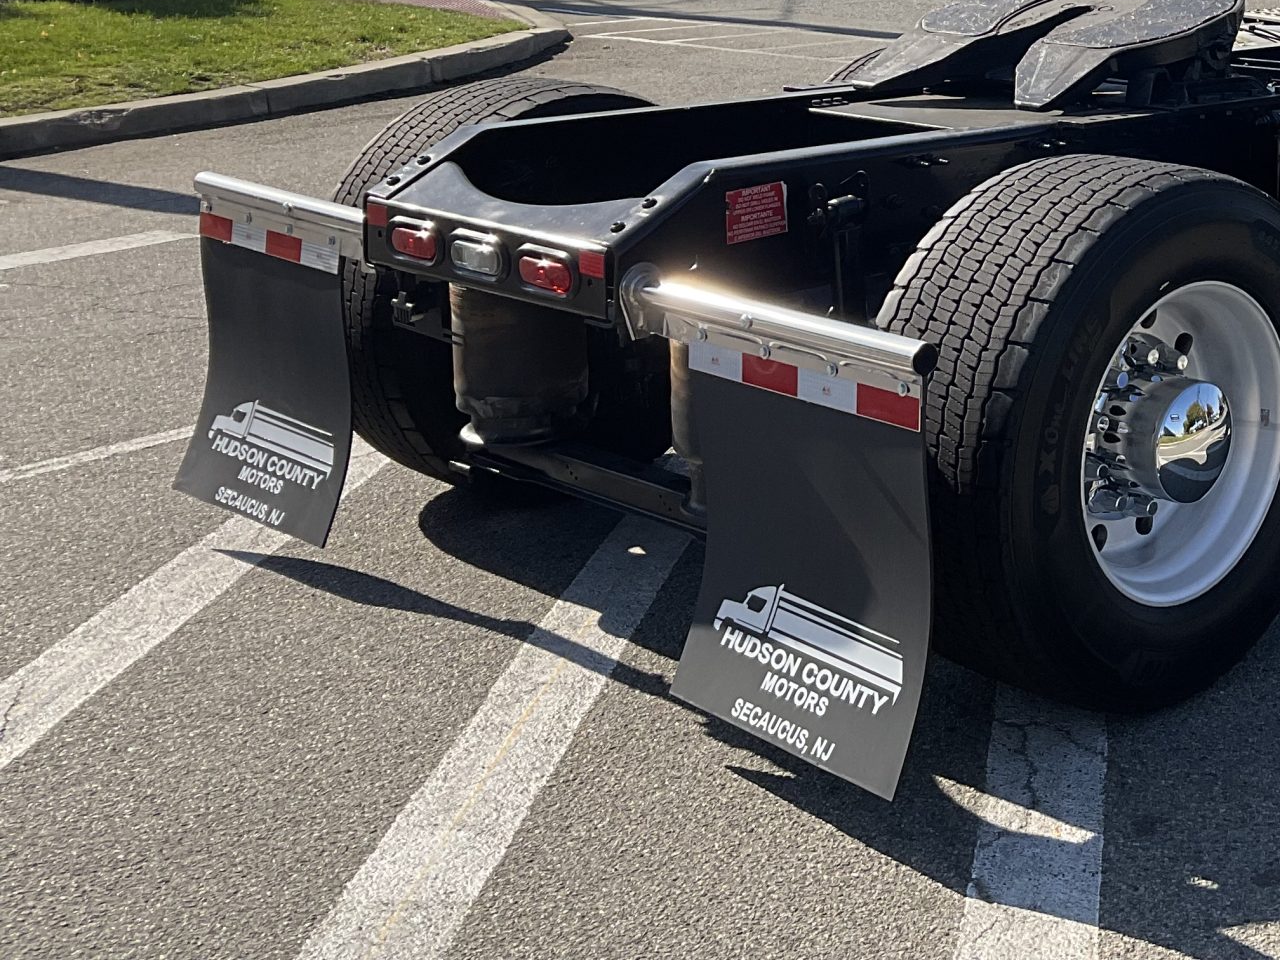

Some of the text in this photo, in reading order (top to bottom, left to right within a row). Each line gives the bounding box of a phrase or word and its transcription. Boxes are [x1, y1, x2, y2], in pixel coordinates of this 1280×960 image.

[211, 436, 324, 490] HUDSON COUNTY
[237, 465, 284, 495] MOTORS
[214, 486, 285, 526] SECAUCUS, NJ
[719, 626, 890, 716] HUDSON COUNTY
[760, 671, 830, 717] MOTORS
[730, 698, 836, 762] SECAUCUS, NJ
